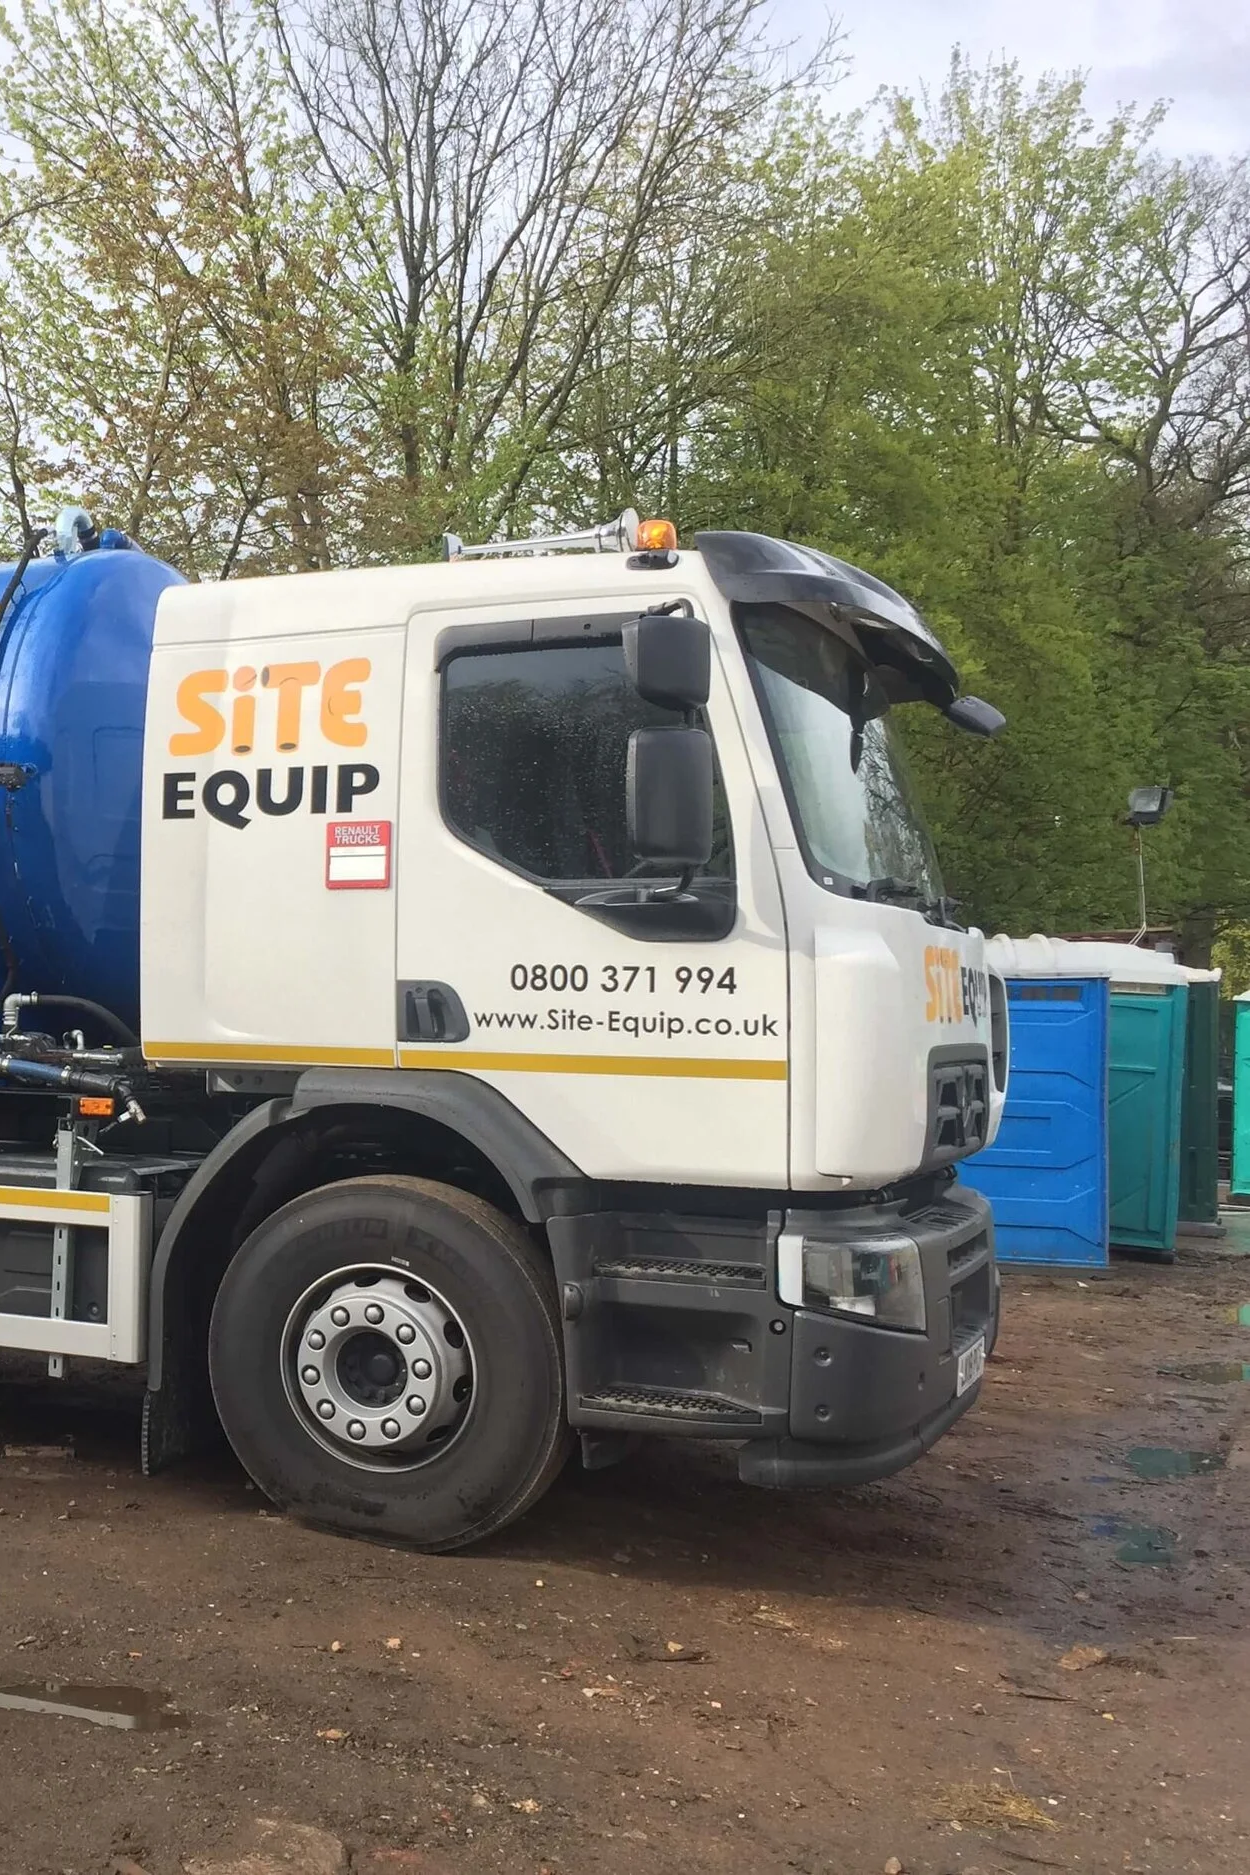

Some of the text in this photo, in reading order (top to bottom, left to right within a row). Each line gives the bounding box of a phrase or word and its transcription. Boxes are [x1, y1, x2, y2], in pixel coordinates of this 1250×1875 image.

[162, 763, 380, 830] EQUIP
[334, 825, 380, 836] RENAULT
[334, 834, 380, 845] TRUCKS
[510, 963, 738, 995] 0800 371 994
[473, 1008, 779, 1039] www.Site-Equip.co.uk
